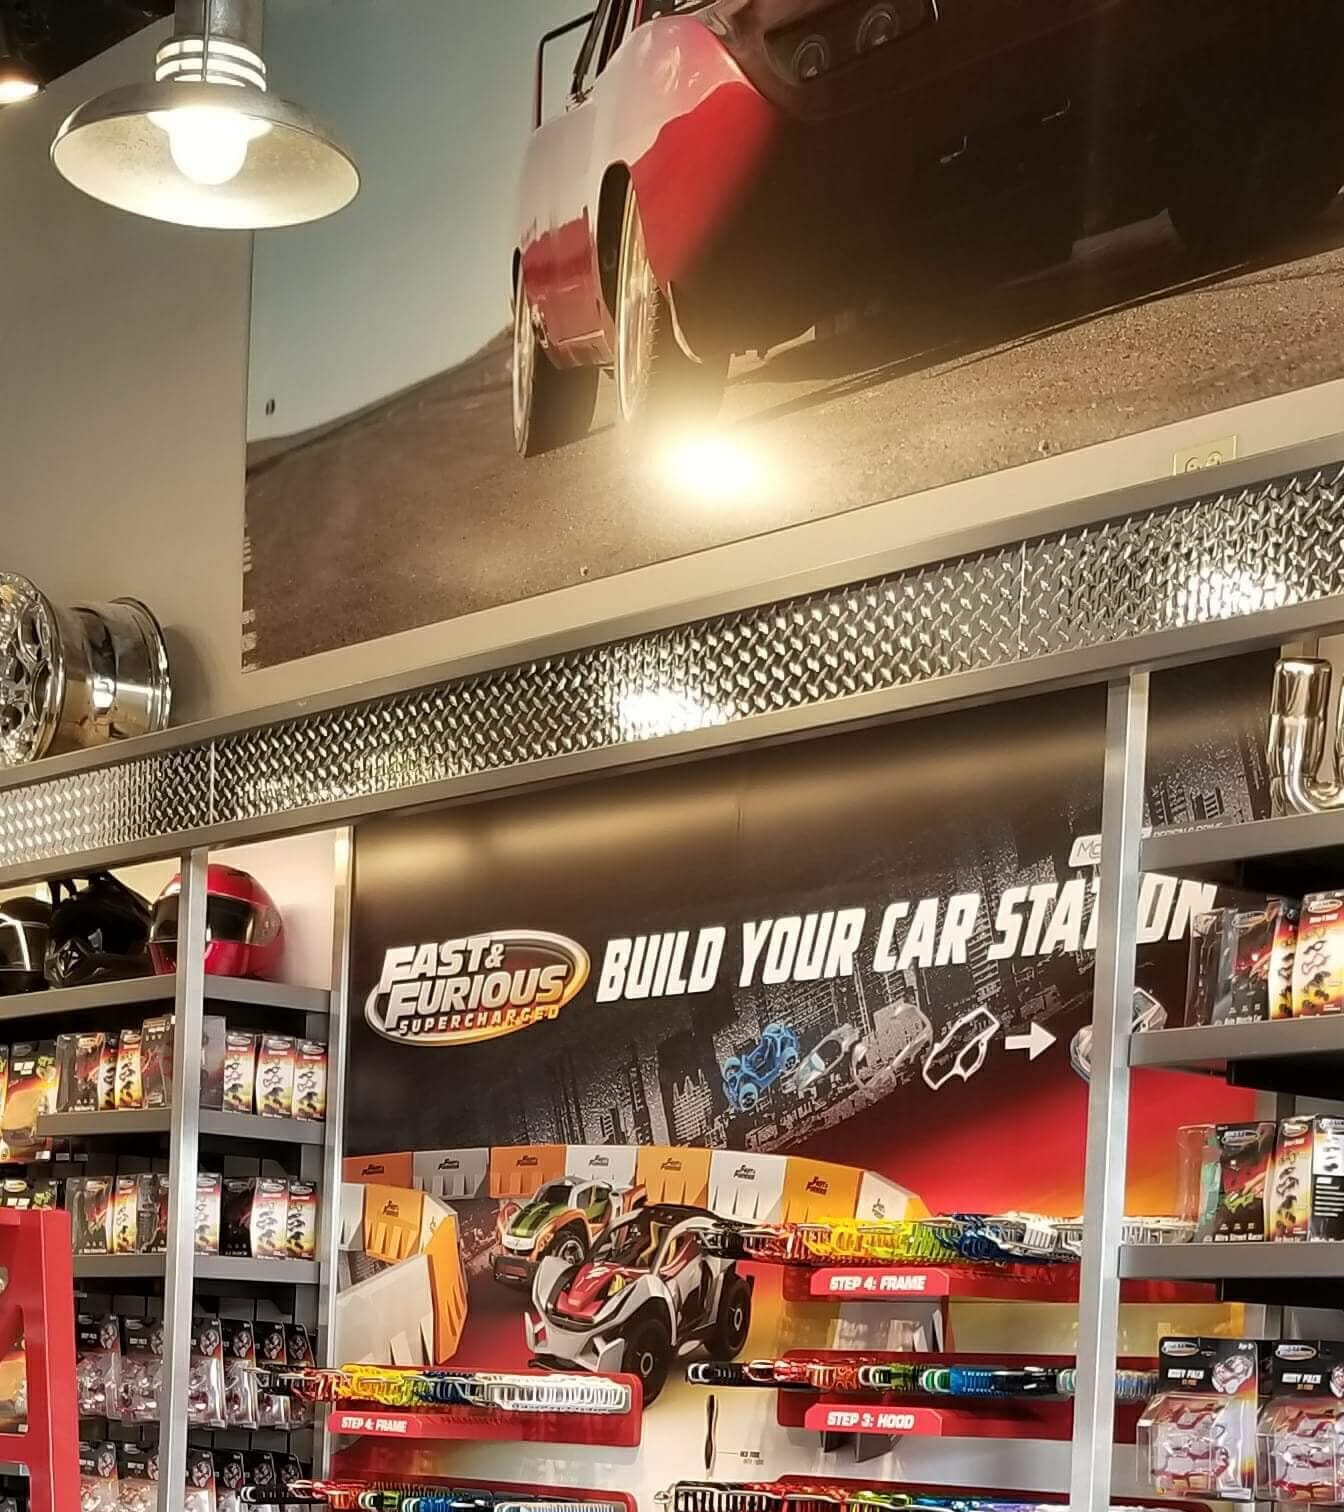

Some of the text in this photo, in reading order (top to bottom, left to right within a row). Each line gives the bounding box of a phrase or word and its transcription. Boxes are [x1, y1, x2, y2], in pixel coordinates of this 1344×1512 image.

[596, 871, 1217, 1002] BUILD YOUR CAR STAON
[377, 936, 490, 993] FAST
[385, 965, 567, 1029] FURIOUS
[400, 1005, 560, 1034] SUPERCHARGED
[830, 1276, 926, 1292] STEP 4: FRAME
[341, 1416, 362, 1430] STEP
[376, 1419, 407, 1433] FRAME
[827, 1413, 914, 1429] STEP 3: HOOD
